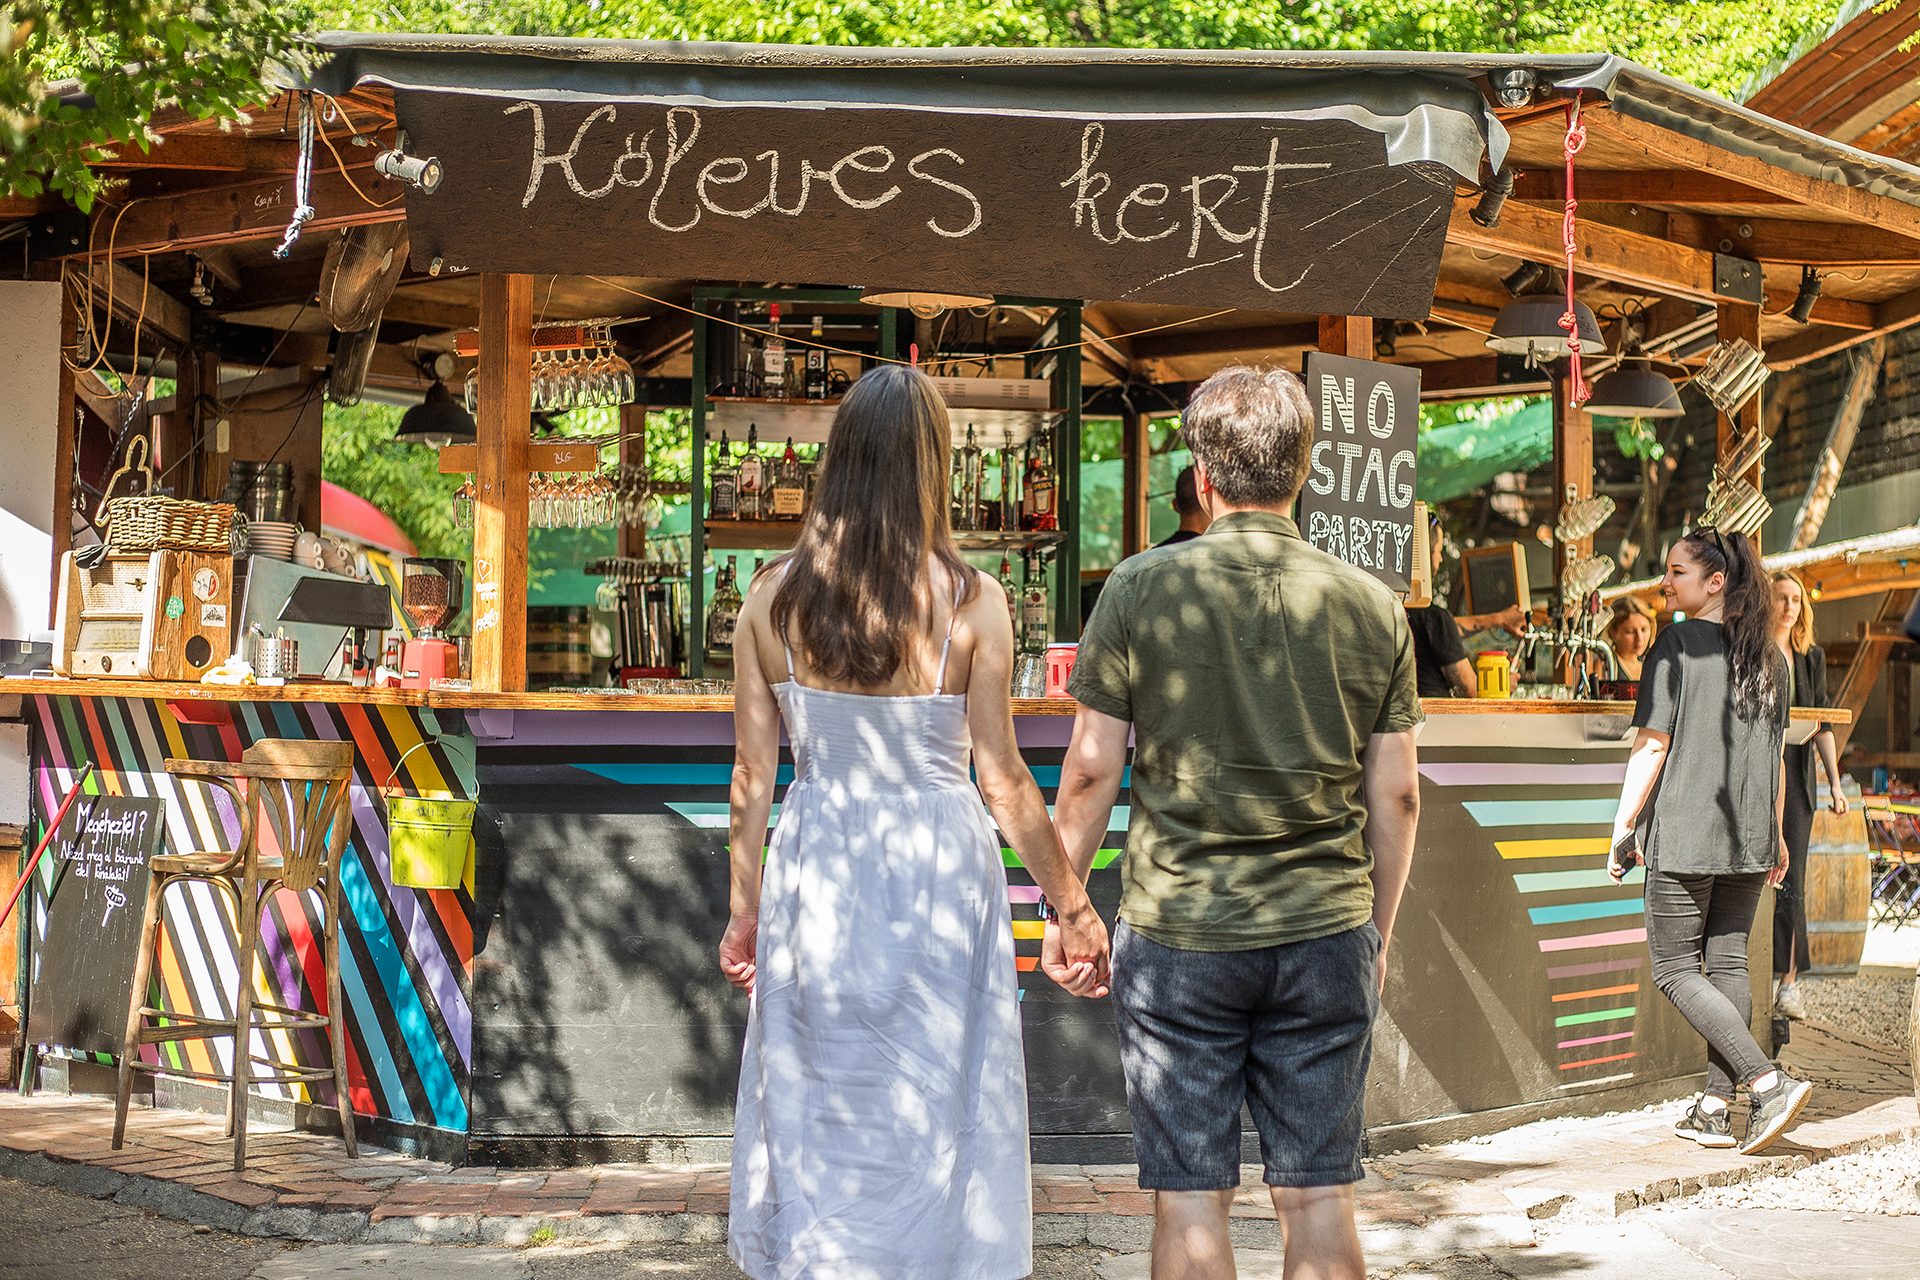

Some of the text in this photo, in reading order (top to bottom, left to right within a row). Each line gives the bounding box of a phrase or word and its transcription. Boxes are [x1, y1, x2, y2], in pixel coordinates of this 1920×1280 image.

[503, 101, 982, 238] Köleves
[1321, 374, 1396, 439] NO
[1308, 440, 1416, 509] STAG
[1308, 511, 1413, 573] PARTY
[86, 852, 103, 867] meg
